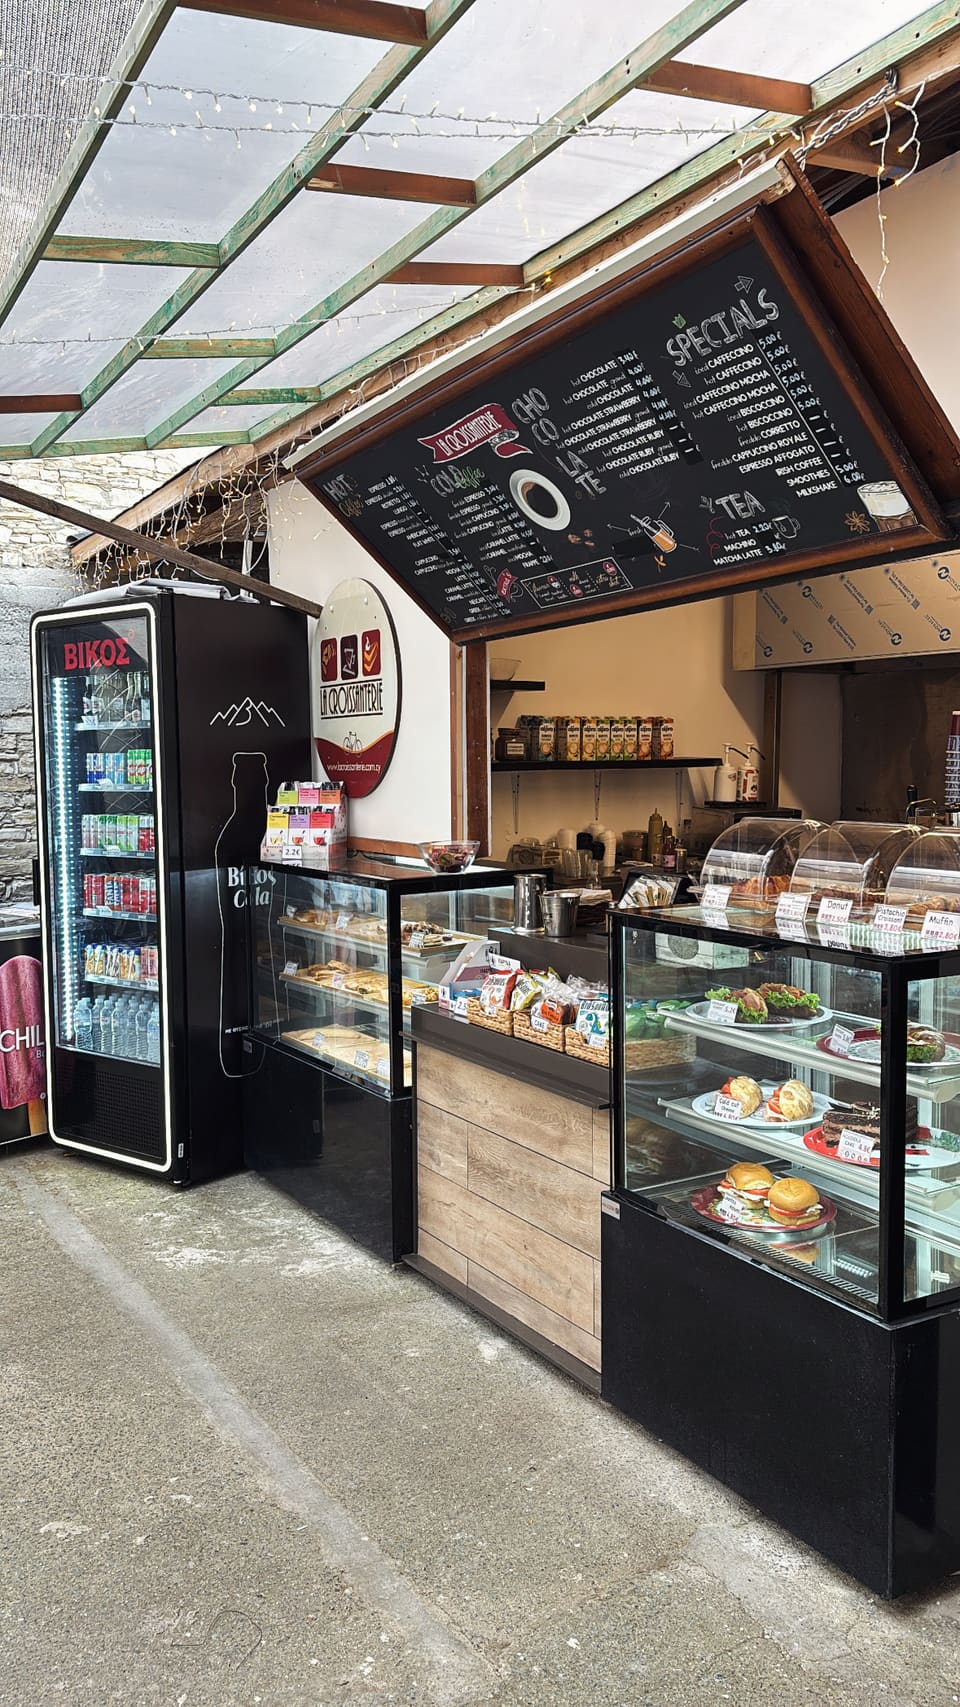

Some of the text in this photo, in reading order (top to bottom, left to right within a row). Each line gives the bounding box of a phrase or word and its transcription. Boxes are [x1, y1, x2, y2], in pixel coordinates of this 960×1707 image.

[666, 288, 780, 367] SPECIALS
[707, 343, 753, 368] CAFFECCINO
[715, 356, 761, 380] CAFFECCINO
[580, 359, 617, 382] CHOCOLATE
[572, 379, 608, 400] CHOCOLATE
[596, 382, 634, 404] CHOCOLATE
[695, 381, 739, 403] CAFFECCINO
[738, 369, 770, 386] MOCHA
[703, 393, 747, 415] CAFFECCINO
[746, 382, 778, 399] MOCHA
[511, 387, 550, 424] CHO
[570, 410, 604, 429] CHOCOLATE
[602, 394, 640, 416] STRAWBERRY
[739, 394, 785, 416] BISCOCCINO
[747, 407, 792, 428] BISCOCCINO
[444, 410, 502, 451] CROISSANTERIE
[531, 417, 560, 446] CO
[564, 427, 597, 446] CHOCOLATE
[595, 413, 631, 433] STRAWBERRY
[586, 431, 620, 450] CHOCOLATE
[618, 417, 656, 437] STRAWBERRY
[760, 419, 800, 438] CORRETTO
[611, 435, 648, 454] CHOCOLATE
[646, 429, 664, 440] RUBY
[731, 441, 777, 461] CAPPUCCINO
[776, 431, 808, 447] ROYALE
[555, 451, 589, 478] LA
[605, 452, 640, 469] CHOCOLATE
[637, 446, 654, 457] RUBY
[628, 456, 664, 474] CHOCOLATE
[662, 452, 679, 462] RUBY
[738, 444, 815, 473] ESPRESSO AFFOGATO
[775, 456, 822, 476] IRISH COFFEE
[323, 473, 354, 502] HOT
[574, 470, 607, 496] TE
[786, 468, 830, 486] SMOOTHIES
[795, 480, 837, 497] MILKSHAKE
[714, 490, 765, 519] TEA
[723, 538, 756, 551] MACHINO
[735, 528, 750, 536] TEA
[713, 553, 742, 565] MATCHA
[741, 548, 763, 559] LATTE
[64, 637, 130, 671] ΒΙΚΟΣ
[320, 681, 384, 716] LA CROISSANTERIE
[827, 900, 849, 910] Donut
[876, 905, 906, 917] Pistachio
[928, 916, 954, 926] Muffin
